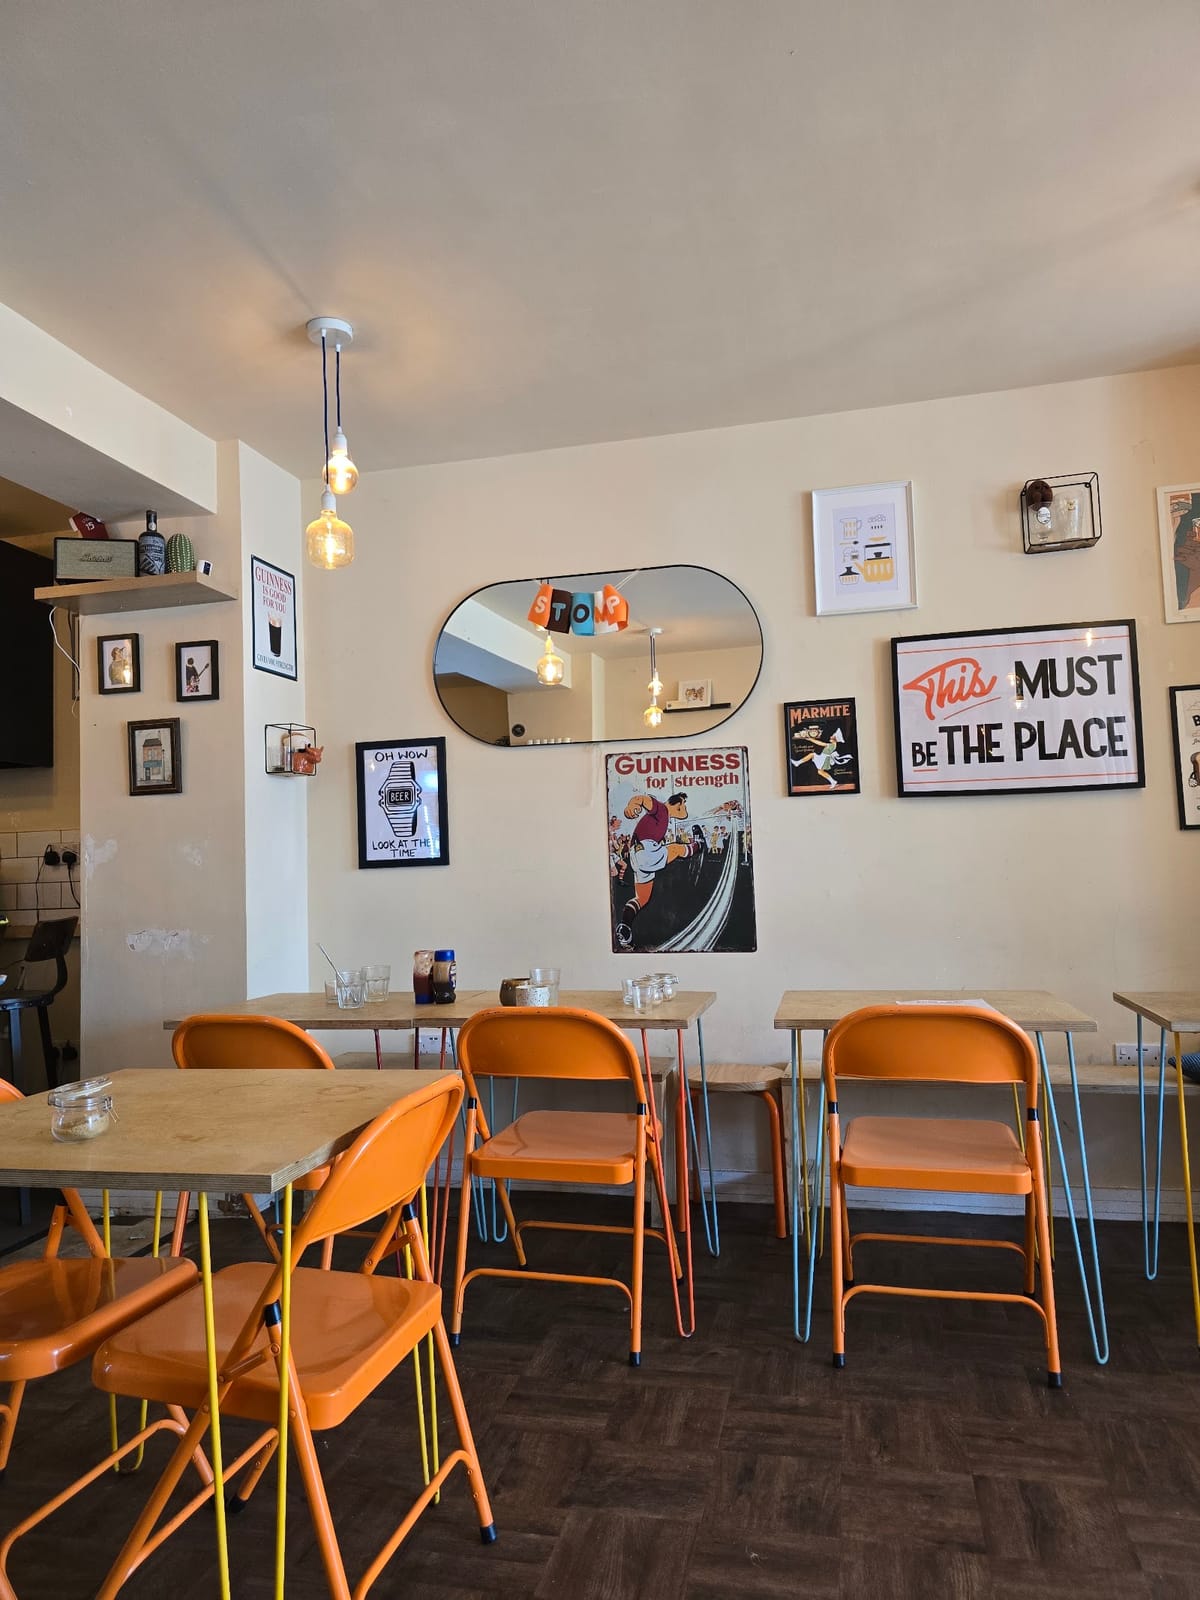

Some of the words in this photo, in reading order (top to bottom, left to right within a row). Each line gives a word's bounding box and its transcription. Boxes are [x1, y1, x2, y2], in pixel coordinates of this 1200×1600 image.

[255, 566, 292, 595] GUINNESS
[262, 585, 269, 595] IS
[269, 587, 287, 603] GOOD
[263, 596, 274, 609] FOR
[274, 600, 287, 614] YOU
[903, 657, 998, 721] This
[1014, 654, 1123, 700] MUST
[790, 704, 851, 729] MARMITE
[911, 741, 938, 768] BE
[938, 723, 1005, 765] THE
[1014, 715, 1128, 762] PLACE
[374, 751, 394, 762] OH
[398, 748, 428, 760] WOW
[614, 753, 741, 776] GUINNESS
[645, 776, 668, 790] for
[674, 772, 739, 788] strength
[390, 791, 410, 802] BEER
[372, 839, 396, 851] LOOK
[397, 839, 409, 849] AT
[411, 838, 432, 848] THE
[390, 848, 417, 858] TIME
